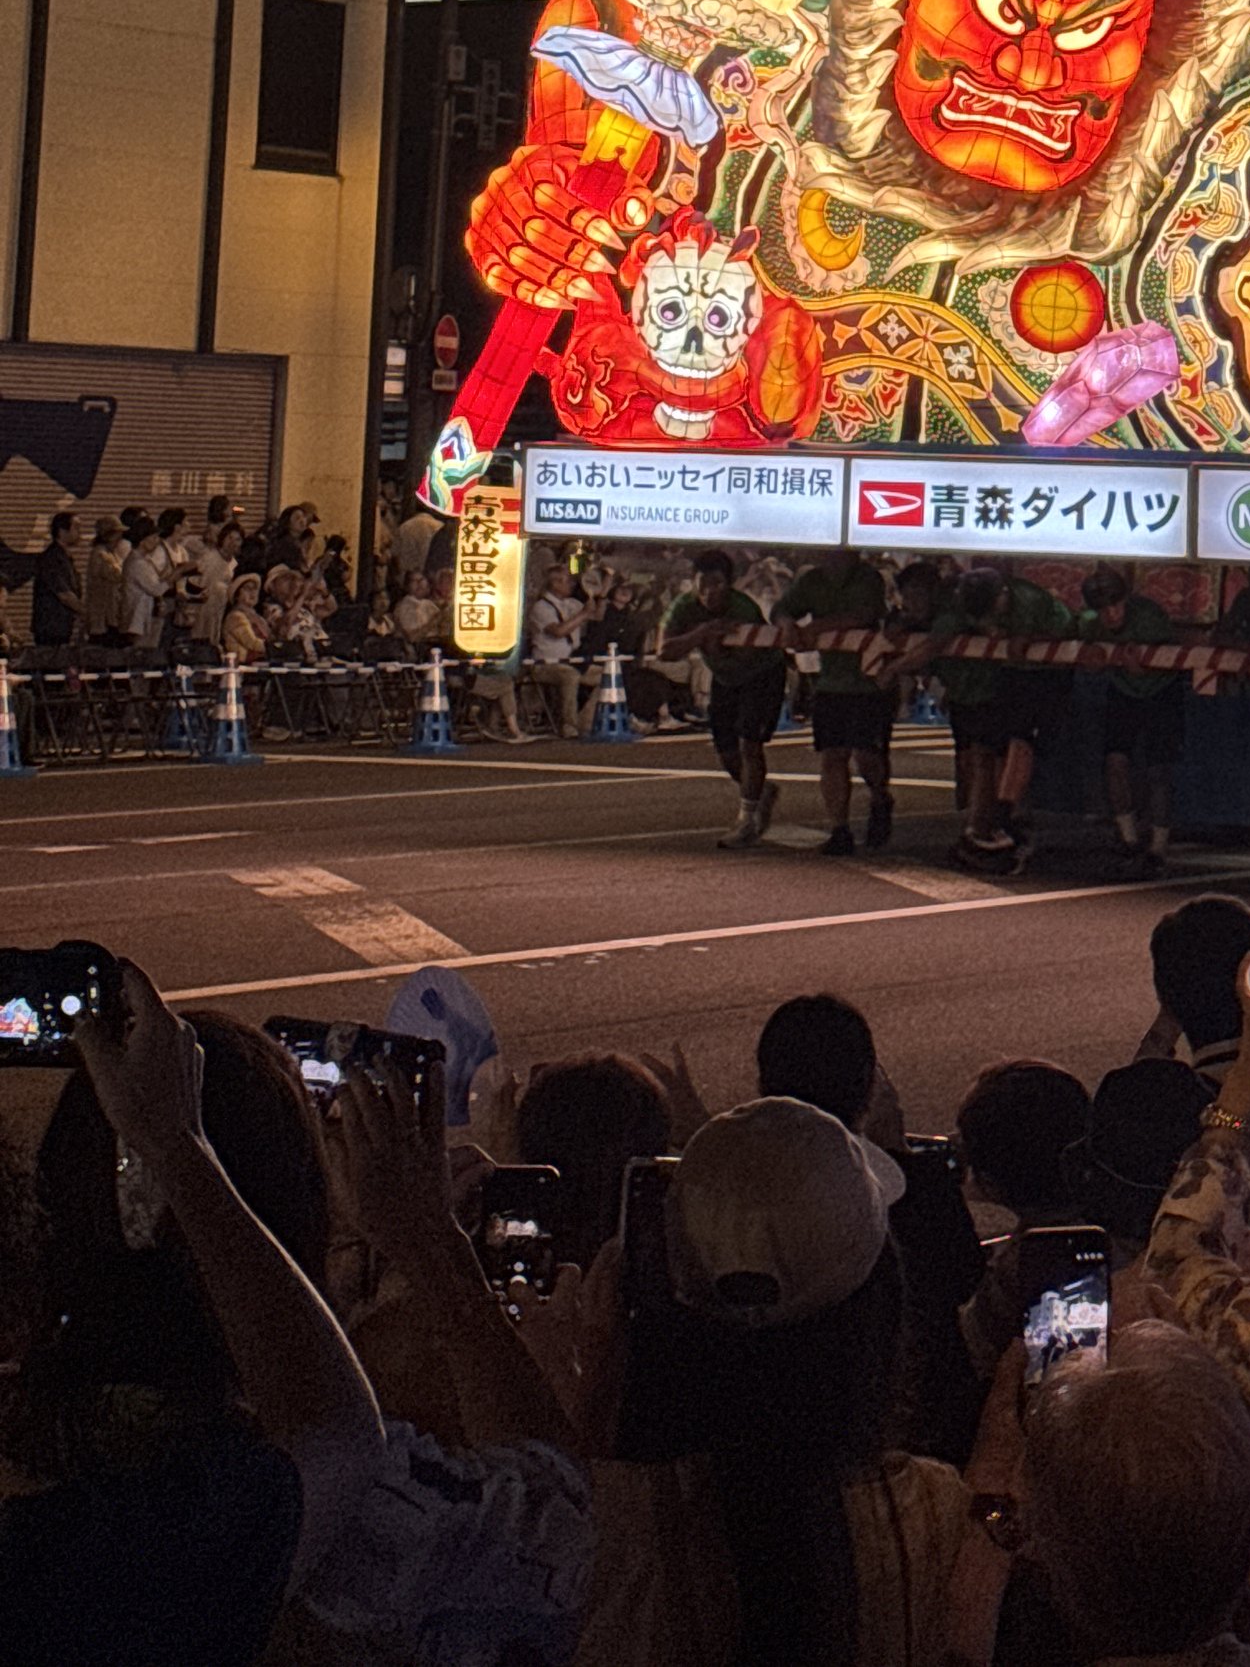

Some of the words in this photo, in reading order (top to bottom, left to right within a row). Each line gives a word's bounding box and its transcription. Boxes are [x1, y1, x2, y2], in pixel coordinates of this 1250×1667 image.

[536, 460, 834, 496] あいおいニッセイ同和損保
[539, 501, 599, 521] MS&AD
[606, 505, 681, 523] INSURANCE
[683, 507, 729, 525] GROUP
[930, 484, 1181, 533] 青森ダイハツ
[458, 494, 501, 631] 青森山田学園
